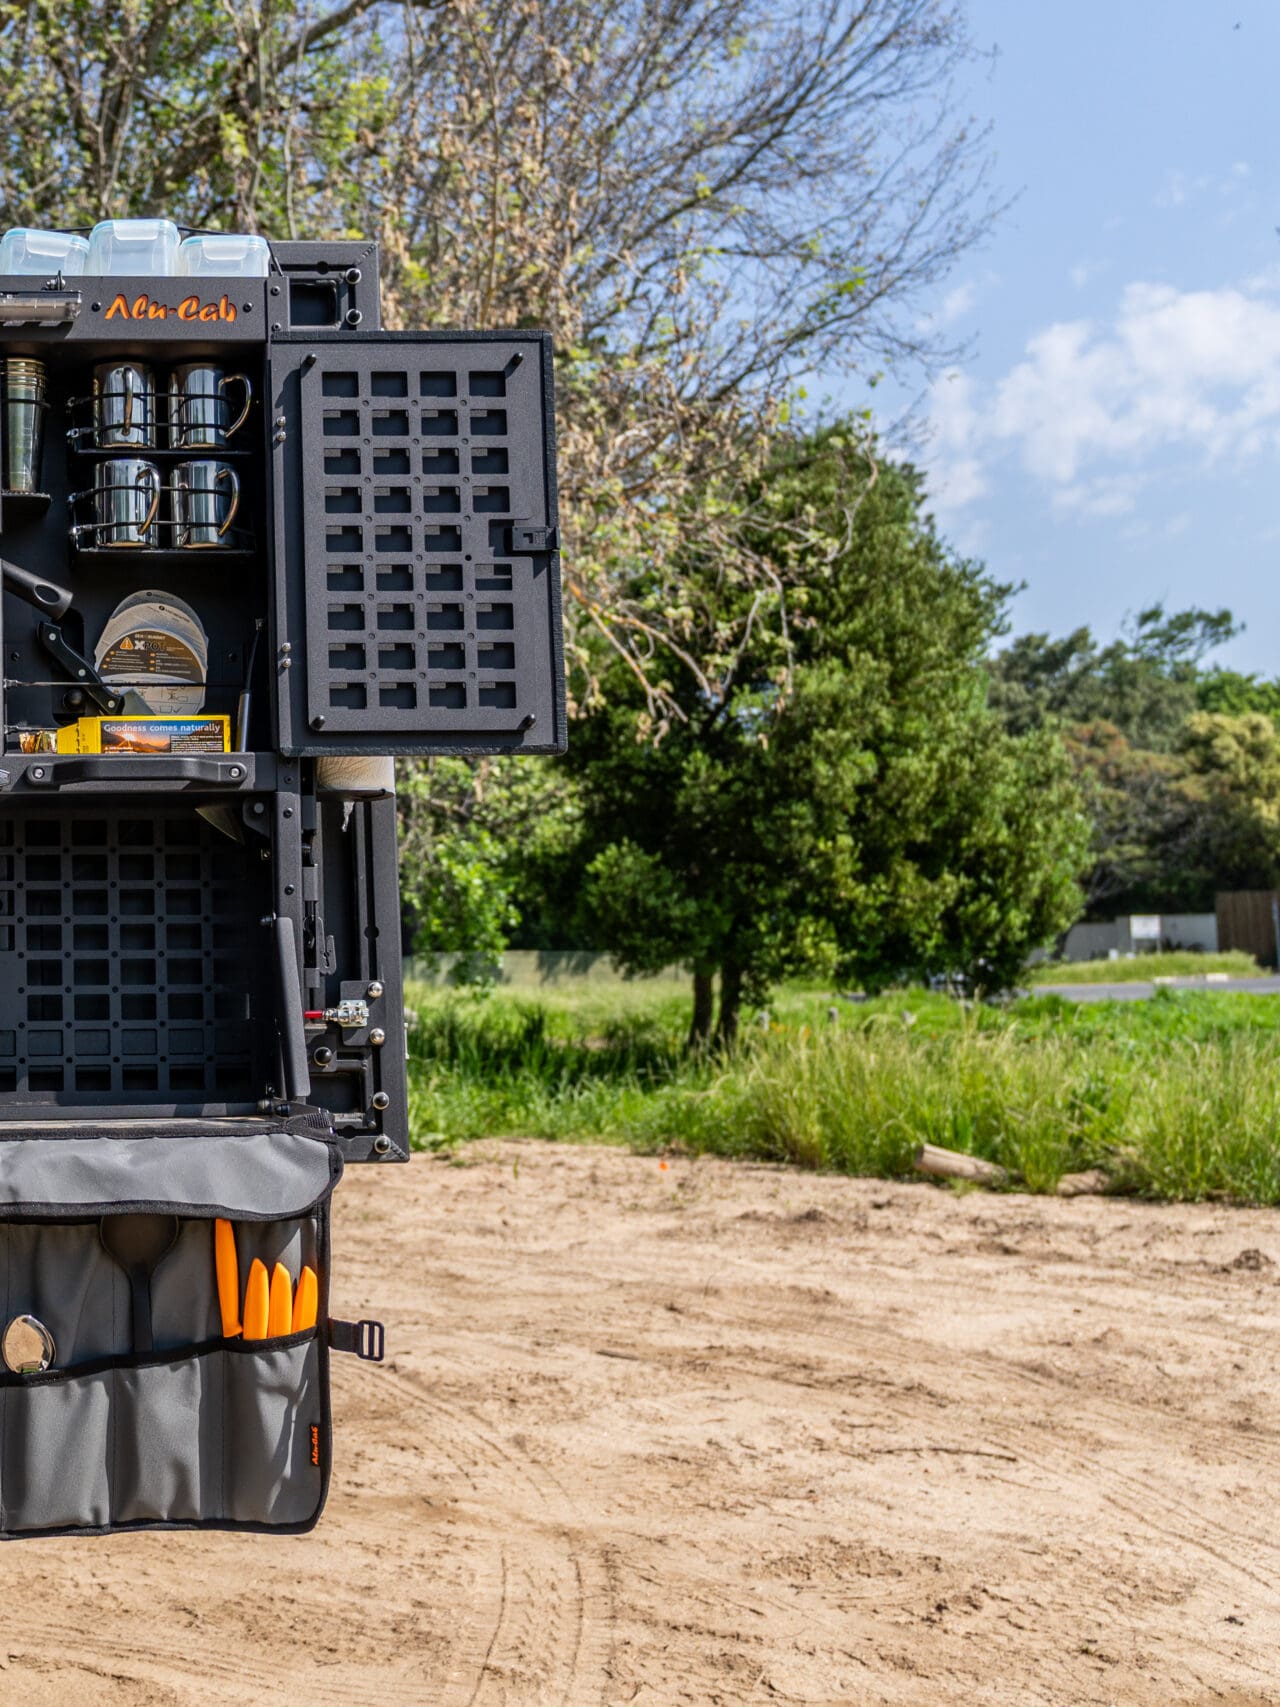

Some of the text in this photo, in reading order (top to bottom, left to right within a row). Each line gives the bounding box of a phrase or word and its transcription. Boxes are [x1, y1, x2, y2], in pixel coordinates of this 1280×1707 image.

[104, 293, 238, 323] Alu-Cab
[103, 723, 221, 734] Goodness comes naturally
